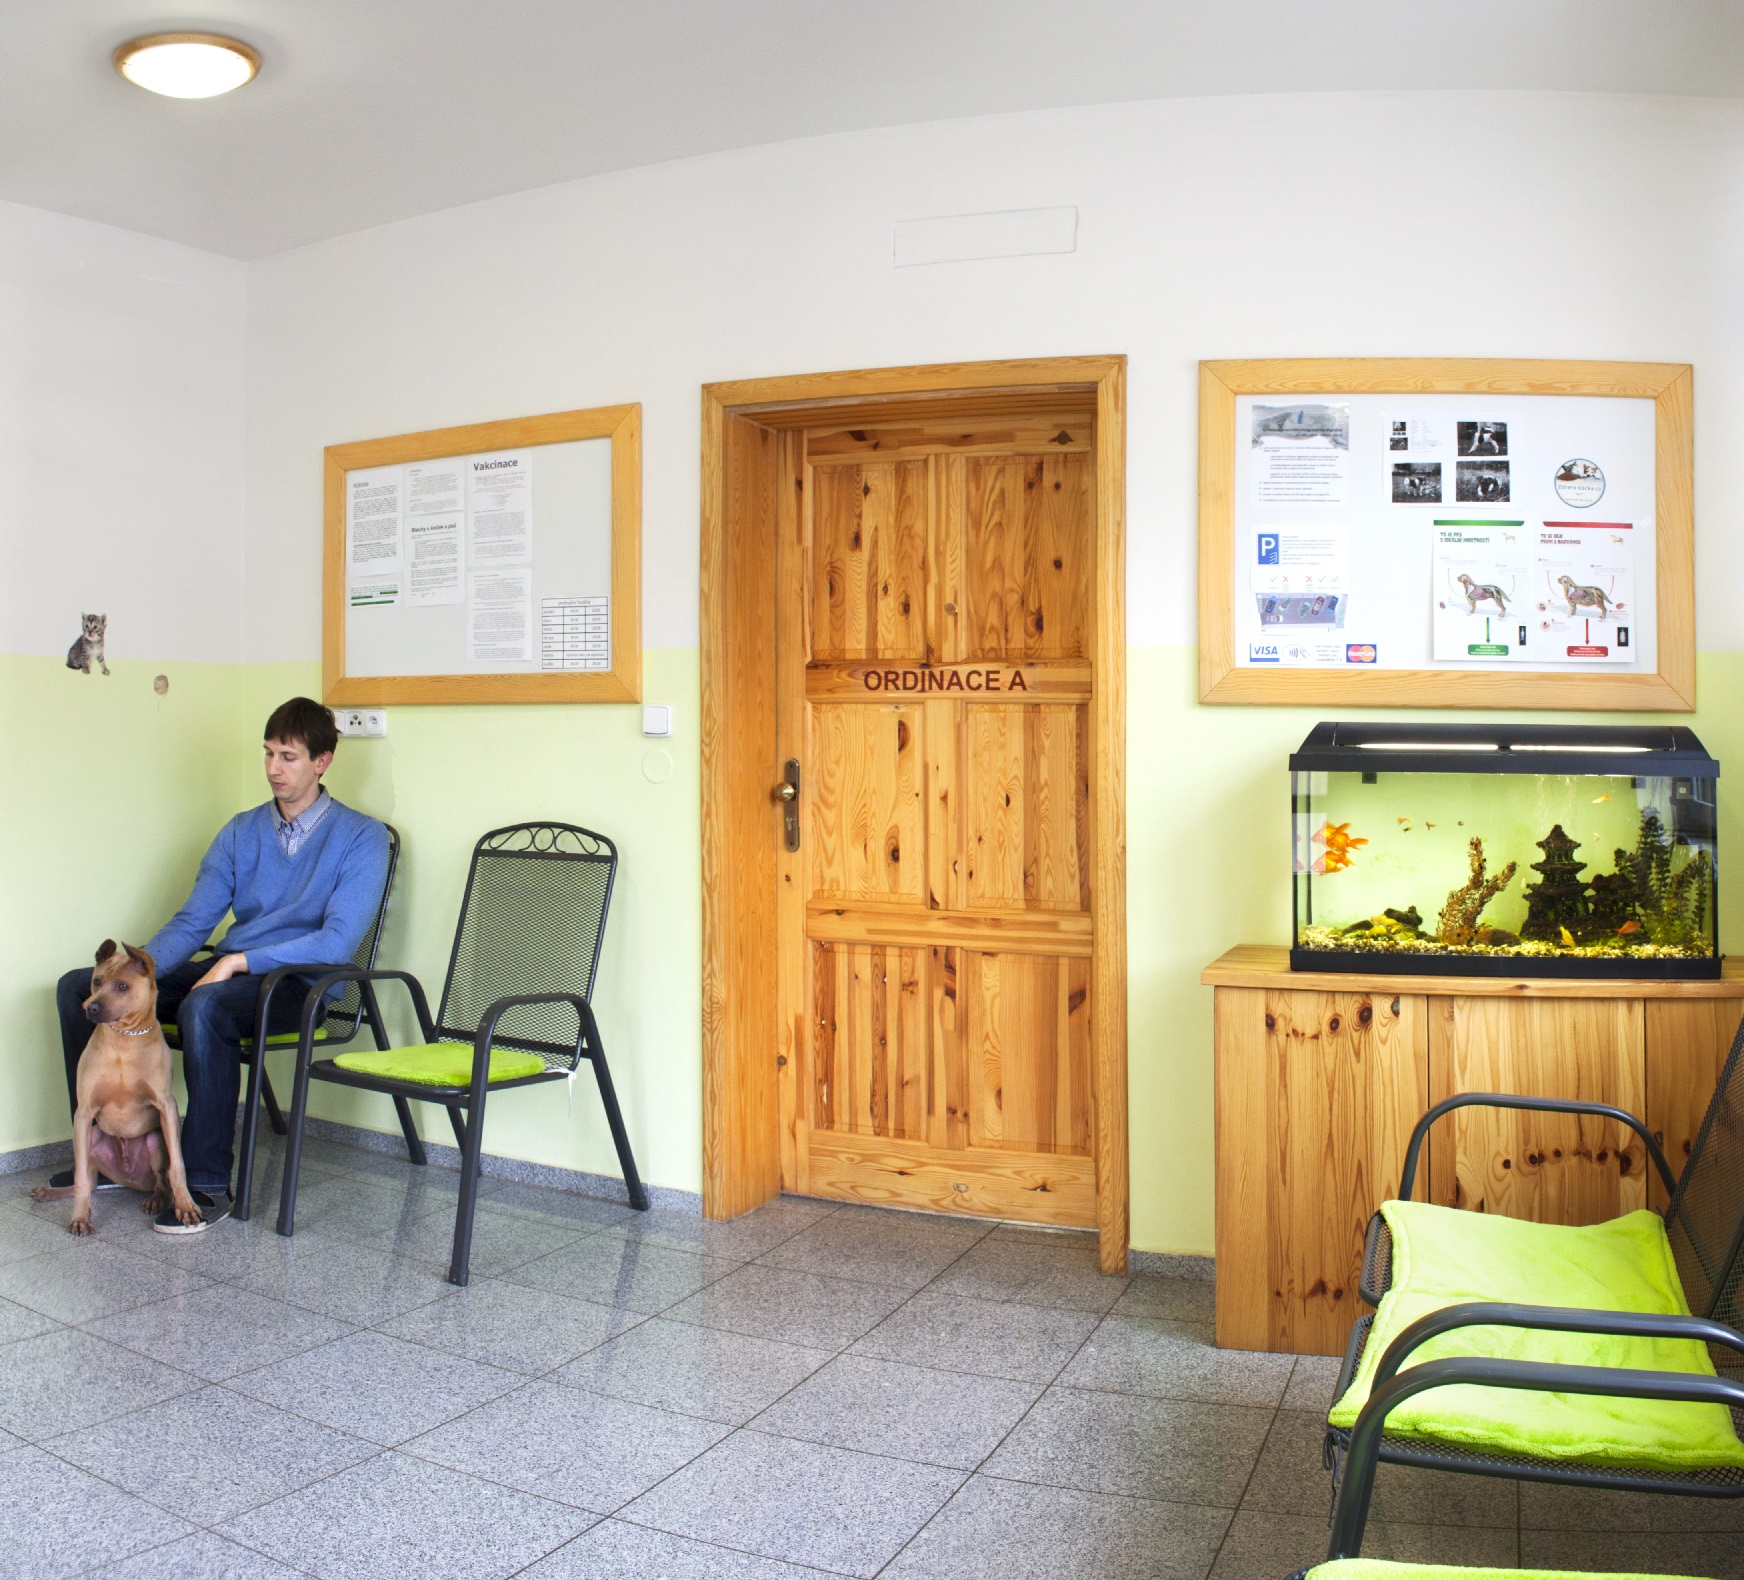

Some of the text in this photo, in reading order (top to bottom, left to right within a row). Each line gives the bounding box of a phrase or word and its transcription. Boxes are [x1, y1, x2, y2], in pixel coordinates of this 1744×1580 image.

[473, 459, 518, 471] Vakcinace
[1261, 537, 1276, 557] P
[1253, 646, 1278, 655] VISA
[863, 669, 1027, 691] ORDINACE A
